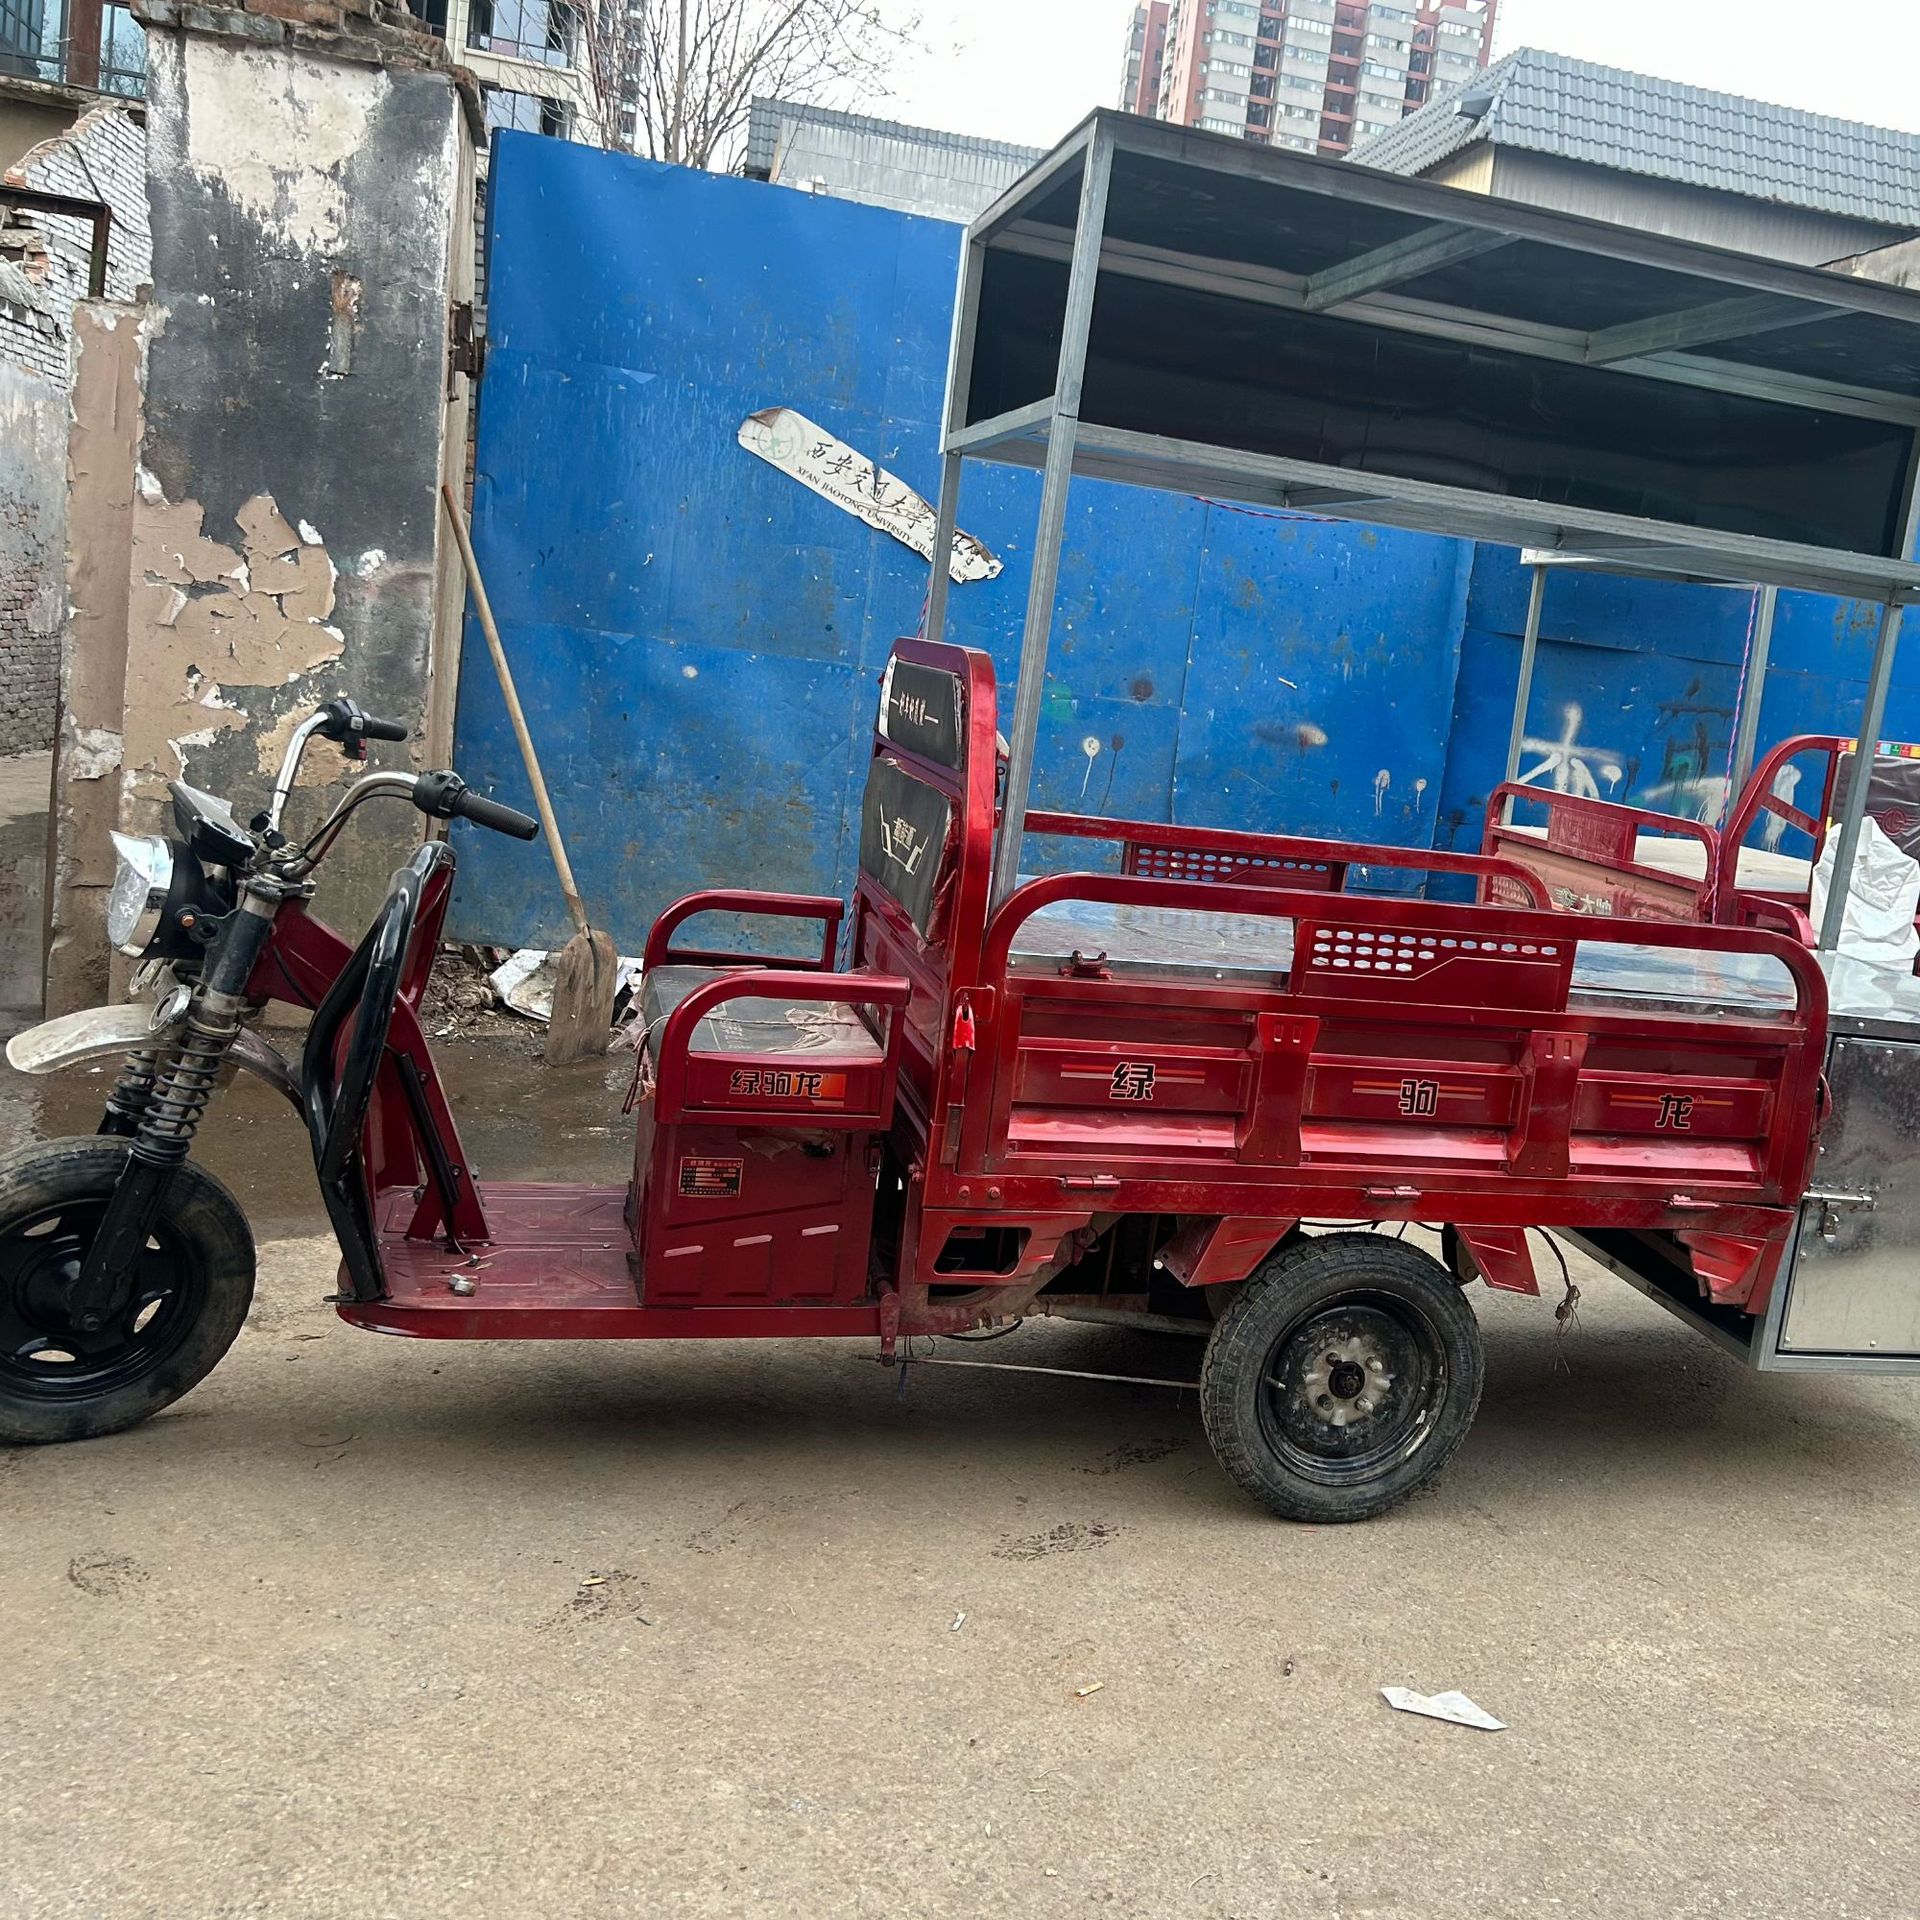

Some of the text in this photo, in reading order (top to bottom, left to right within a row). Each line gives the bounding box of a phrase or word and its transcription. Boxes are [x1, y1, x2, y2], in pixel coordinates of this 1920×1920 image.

[821, 482, 864, 513] JIAOTONG
[867, 509, 913, 542] UNIVERSITY
[729, 1069, 823, 1098] 绿驹龙
[1109, 1061, 1694, 1129] 绿 驹 龙
